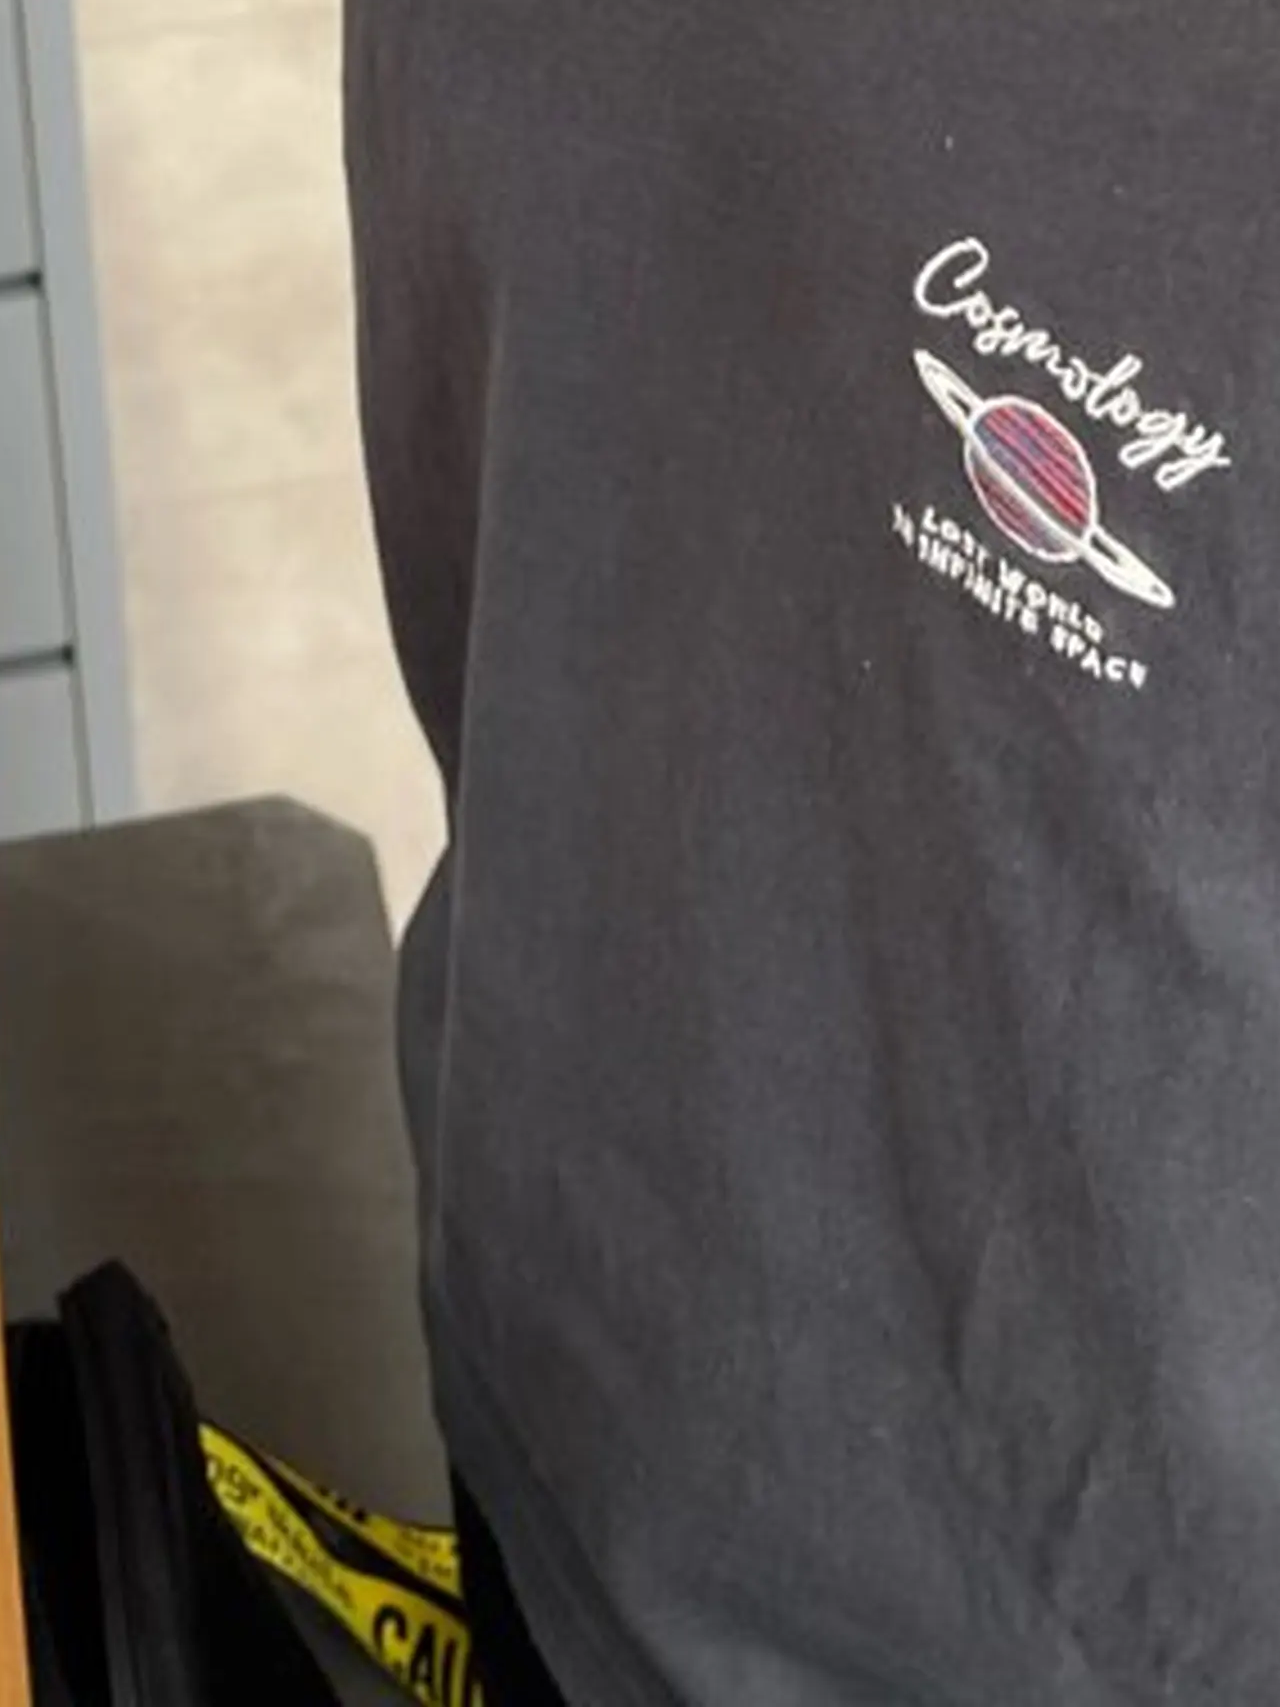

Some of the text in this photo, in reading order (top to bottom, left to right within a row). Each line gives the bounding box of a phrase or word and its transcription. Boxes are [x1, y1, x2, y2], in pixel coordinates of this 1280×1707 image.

[914, 237, 1231, 490] Cosmology
[919, 534, 1038, 635] INFINITE
[1050, 624, 1147, 689] SPACE
[923, 505, 1104, 644] LOST WORLD
